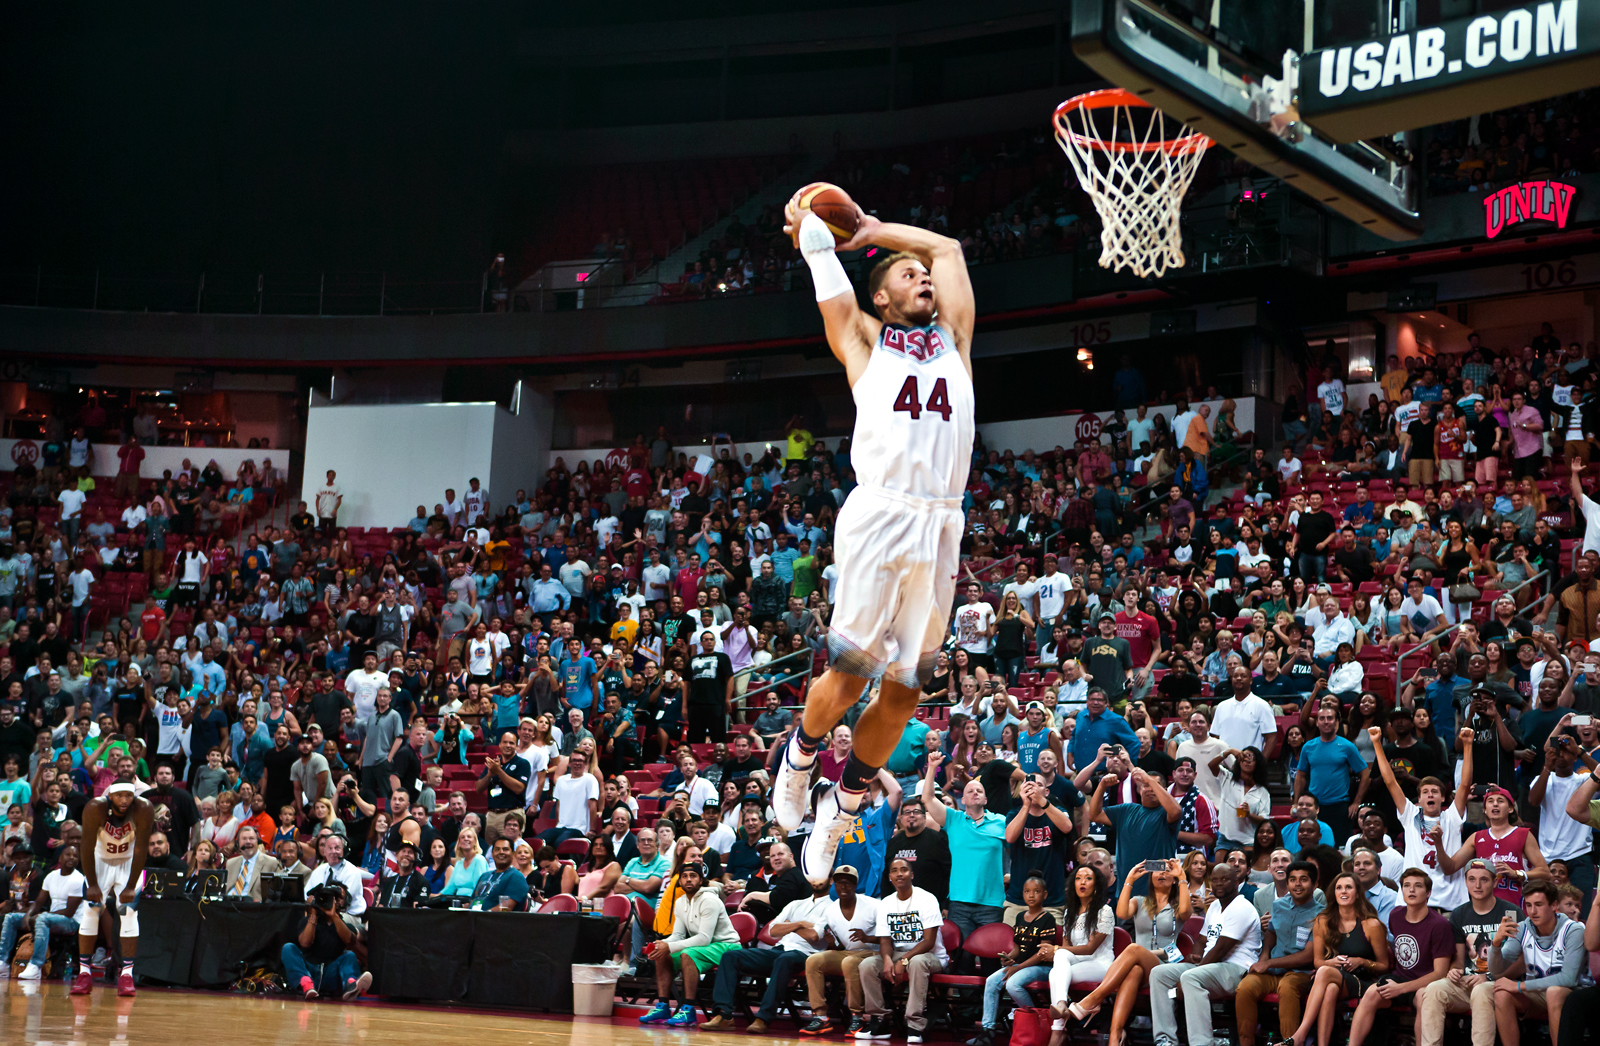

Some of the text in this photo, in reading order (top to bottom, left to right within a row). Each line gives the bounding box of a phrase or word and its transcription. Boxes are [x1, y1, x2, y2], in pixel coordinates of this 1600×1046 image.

[1318, 0, 1579, 97] USAB.COM
[1484, 180, 1576, 239] UNLV
[1520, 259, 1577, 291] 106
[1070, 321, 1111, 347] 105
[883, 328, 945, 362] USA
[893, 375, 953, 422] 44
[1077, 420, 1100, 438] 105
[14, 444, 36, 462] 103
[607, 454, 628, 469] 104
[1040, 584, 1053, 598] 21
[383, 621, 395, 632] 24
[1117, 623, 1142, 631] UNLV
[1091, 644, 1118, 659] USA
[1518, 681, 1532, 692] US
[1025, 755, 1033, 763] 35
[104, 821, 132, 841] USA
[1023, 826, 1052, 843] USA
[1422, 850, 1436, 869] 4
[889, 921, 923, 933] LUTHER
[1462, 924, 1482, 934] YOU'RE
